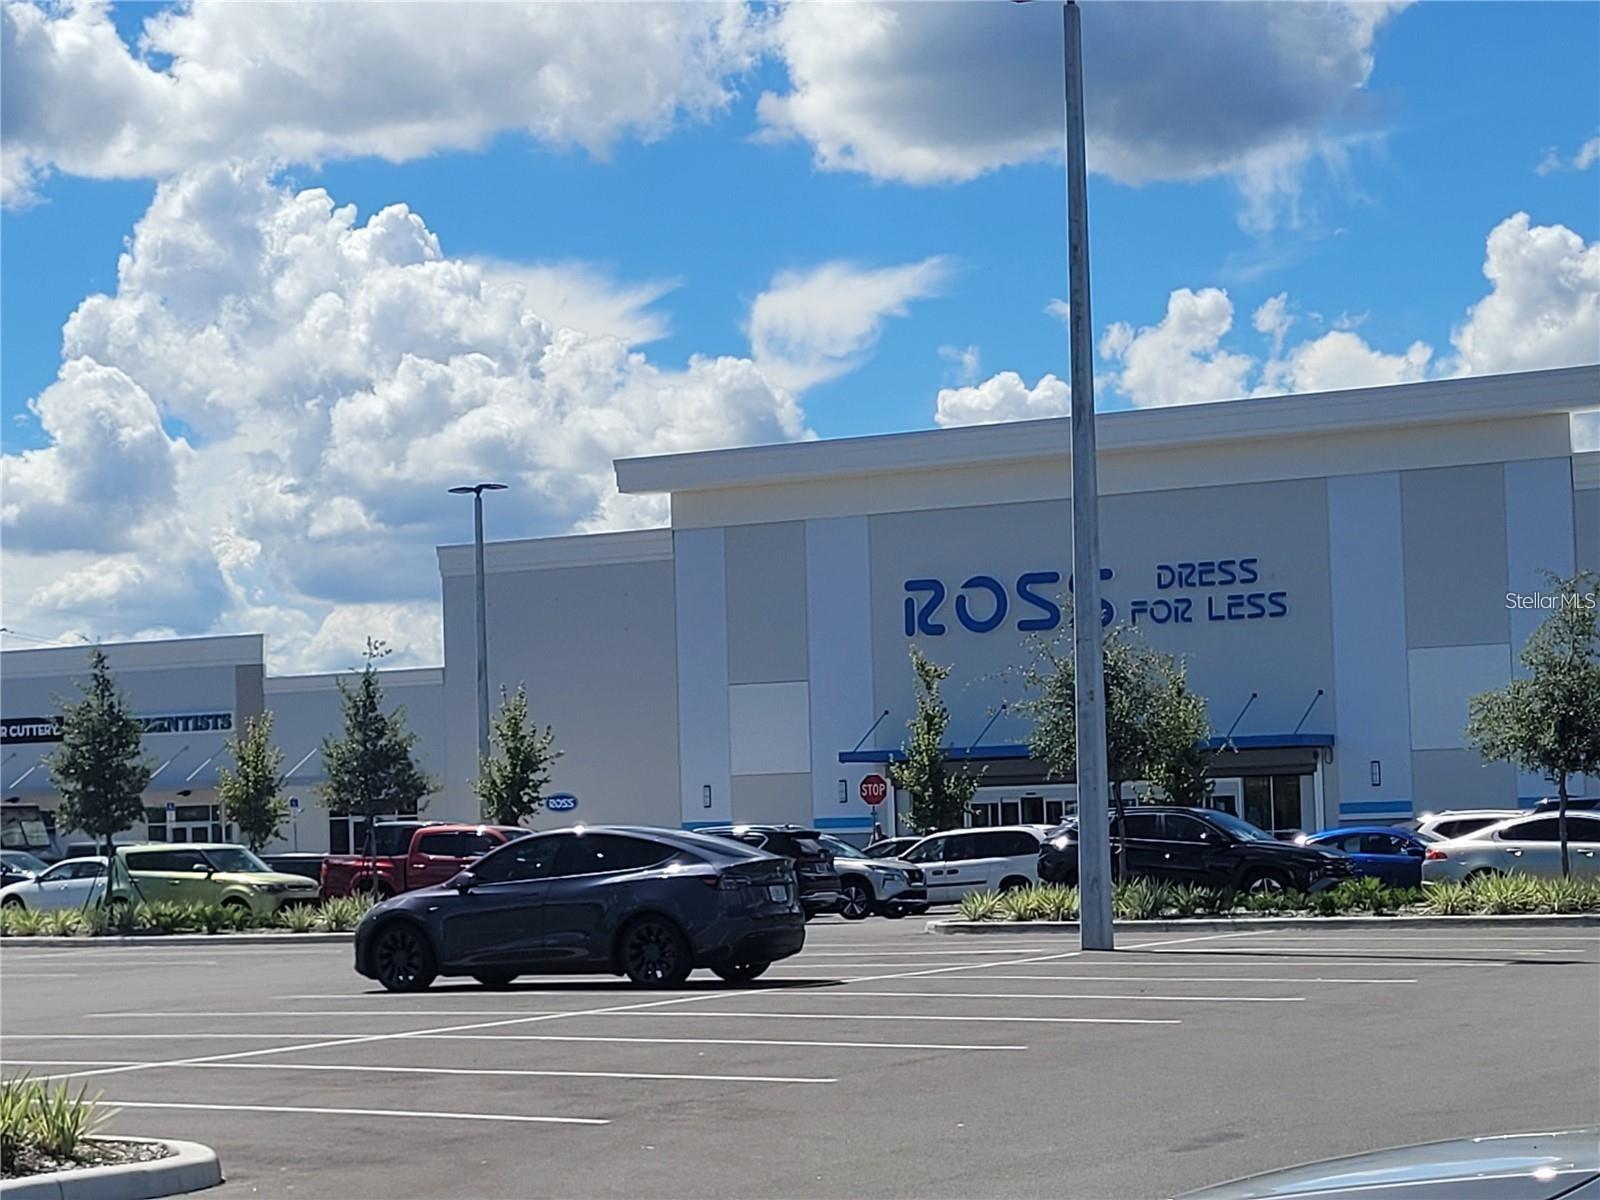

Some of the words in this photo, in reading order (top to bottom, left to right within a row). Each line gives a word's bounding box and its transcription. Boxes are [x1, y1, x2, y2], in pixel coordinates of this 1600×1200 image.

[1156, 558, 1259, 590] DRESS
[1130, 597, 1193, 626] FOR
[1207, 591, 1288, 621] LESS
[9, 722, 60, 738] CUTTERY
[861, 783, 886, 797] STOP
[549, 798, 575, 809] ROSS
